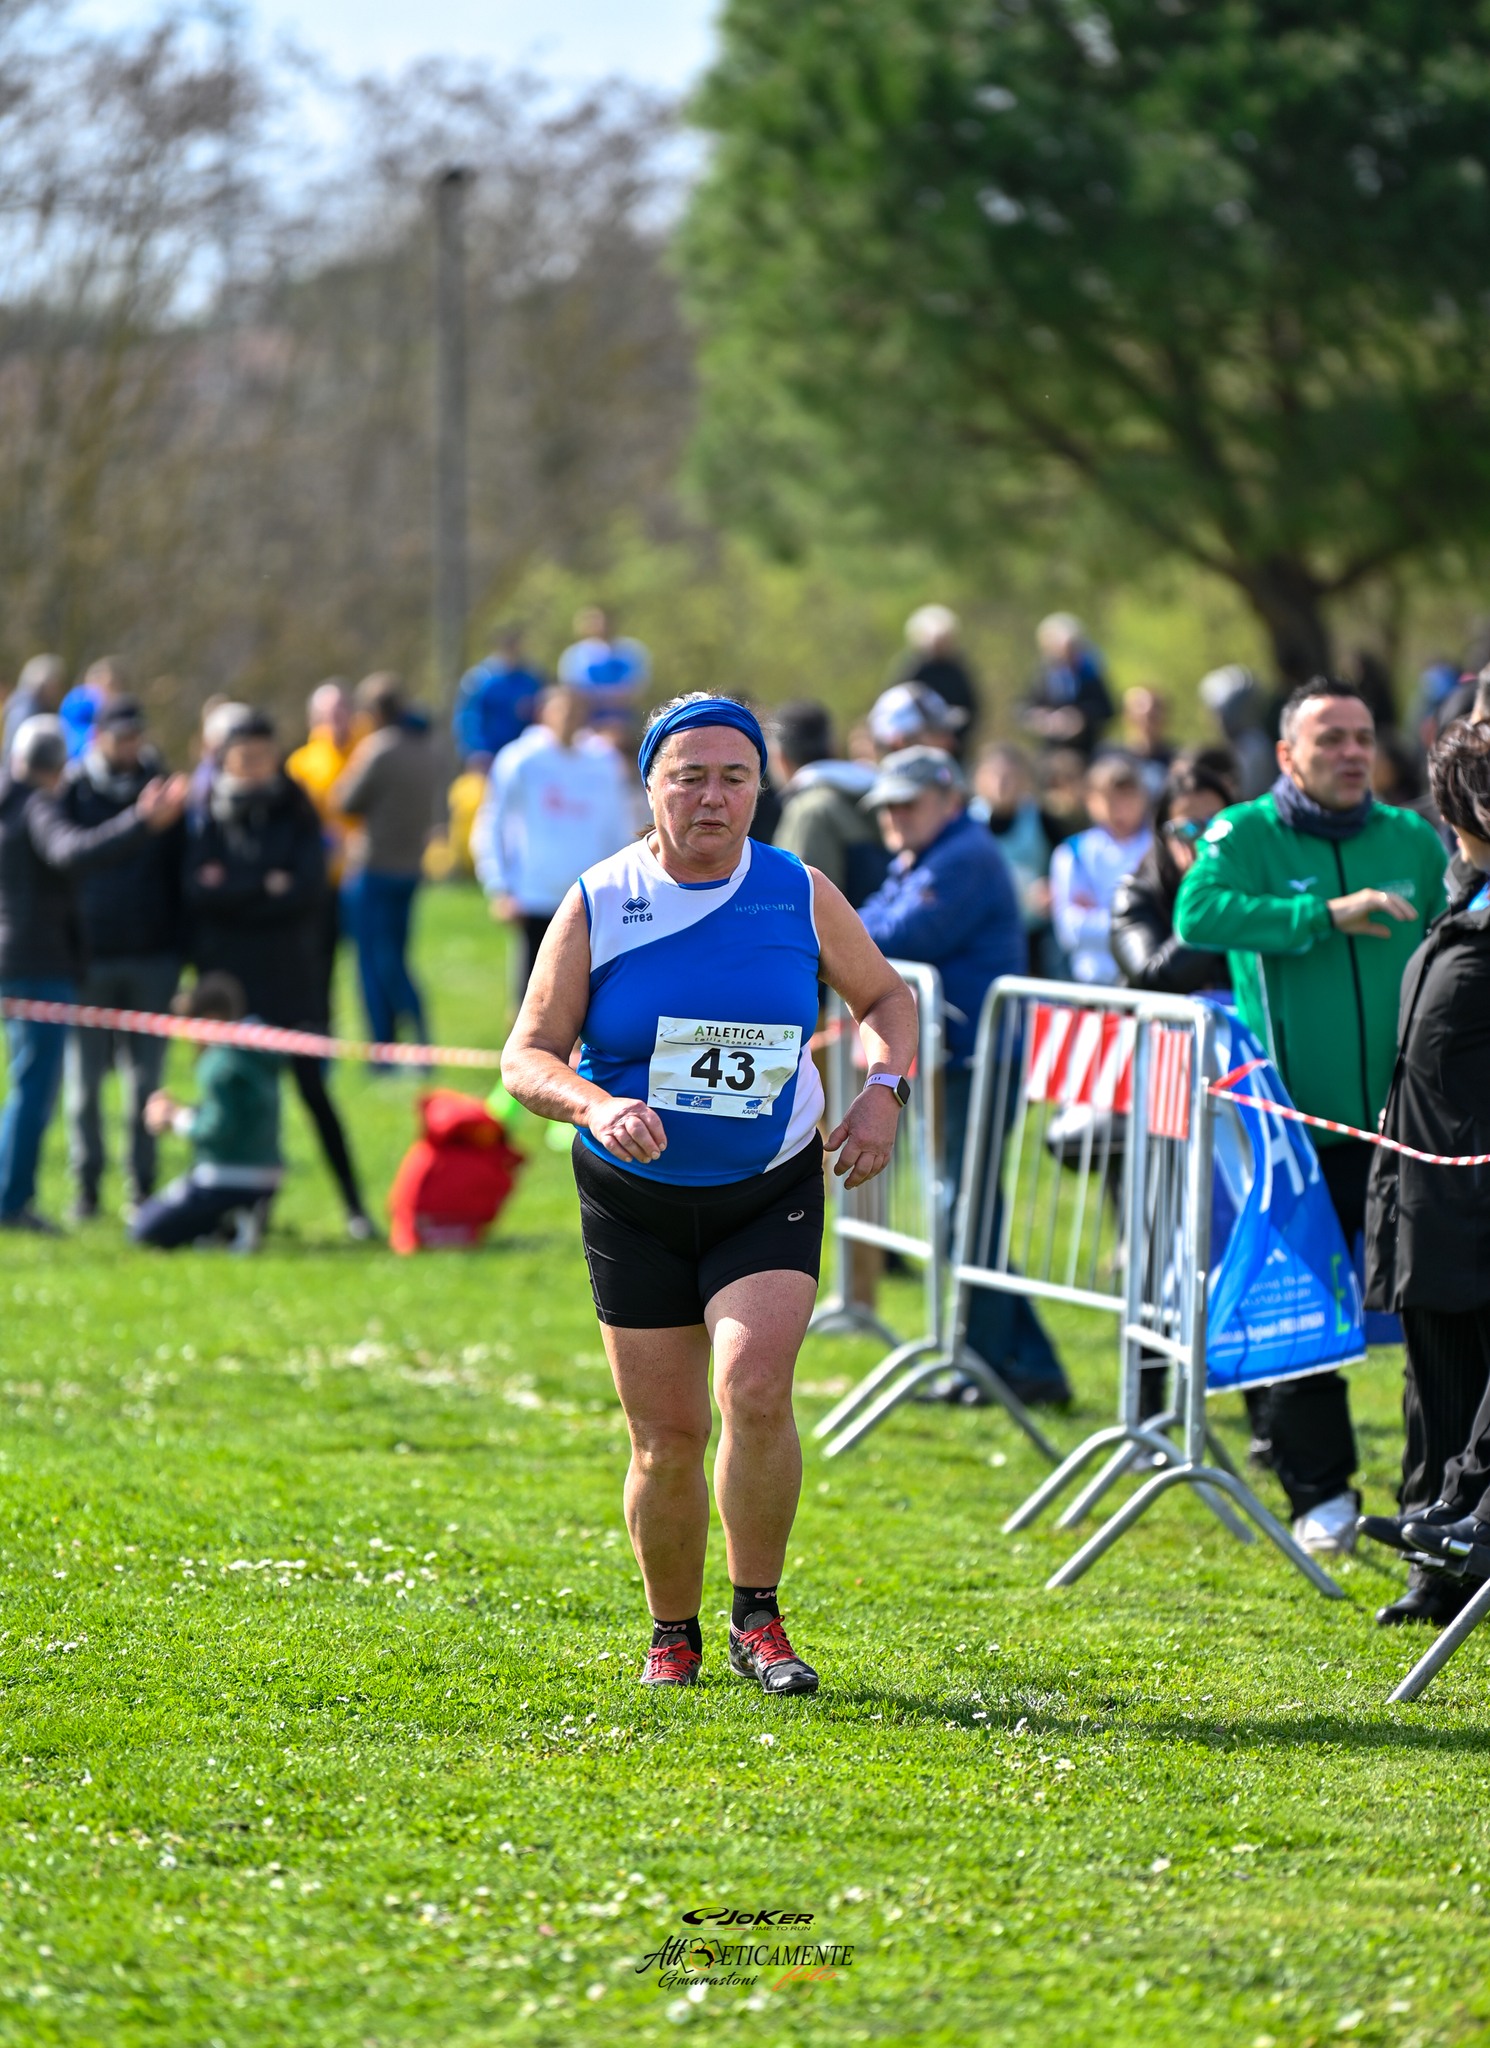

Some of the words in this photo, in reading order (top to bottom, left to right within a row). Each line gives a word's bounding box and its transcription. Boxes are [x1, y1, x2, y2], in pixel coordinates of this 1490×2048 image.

[622, 912, 653, 924] errea
[694, 1025, 765, 1040] ATLETICA
[783, 1030, 795, 1040] S3
[690, 1047, 756, 1091] 43
